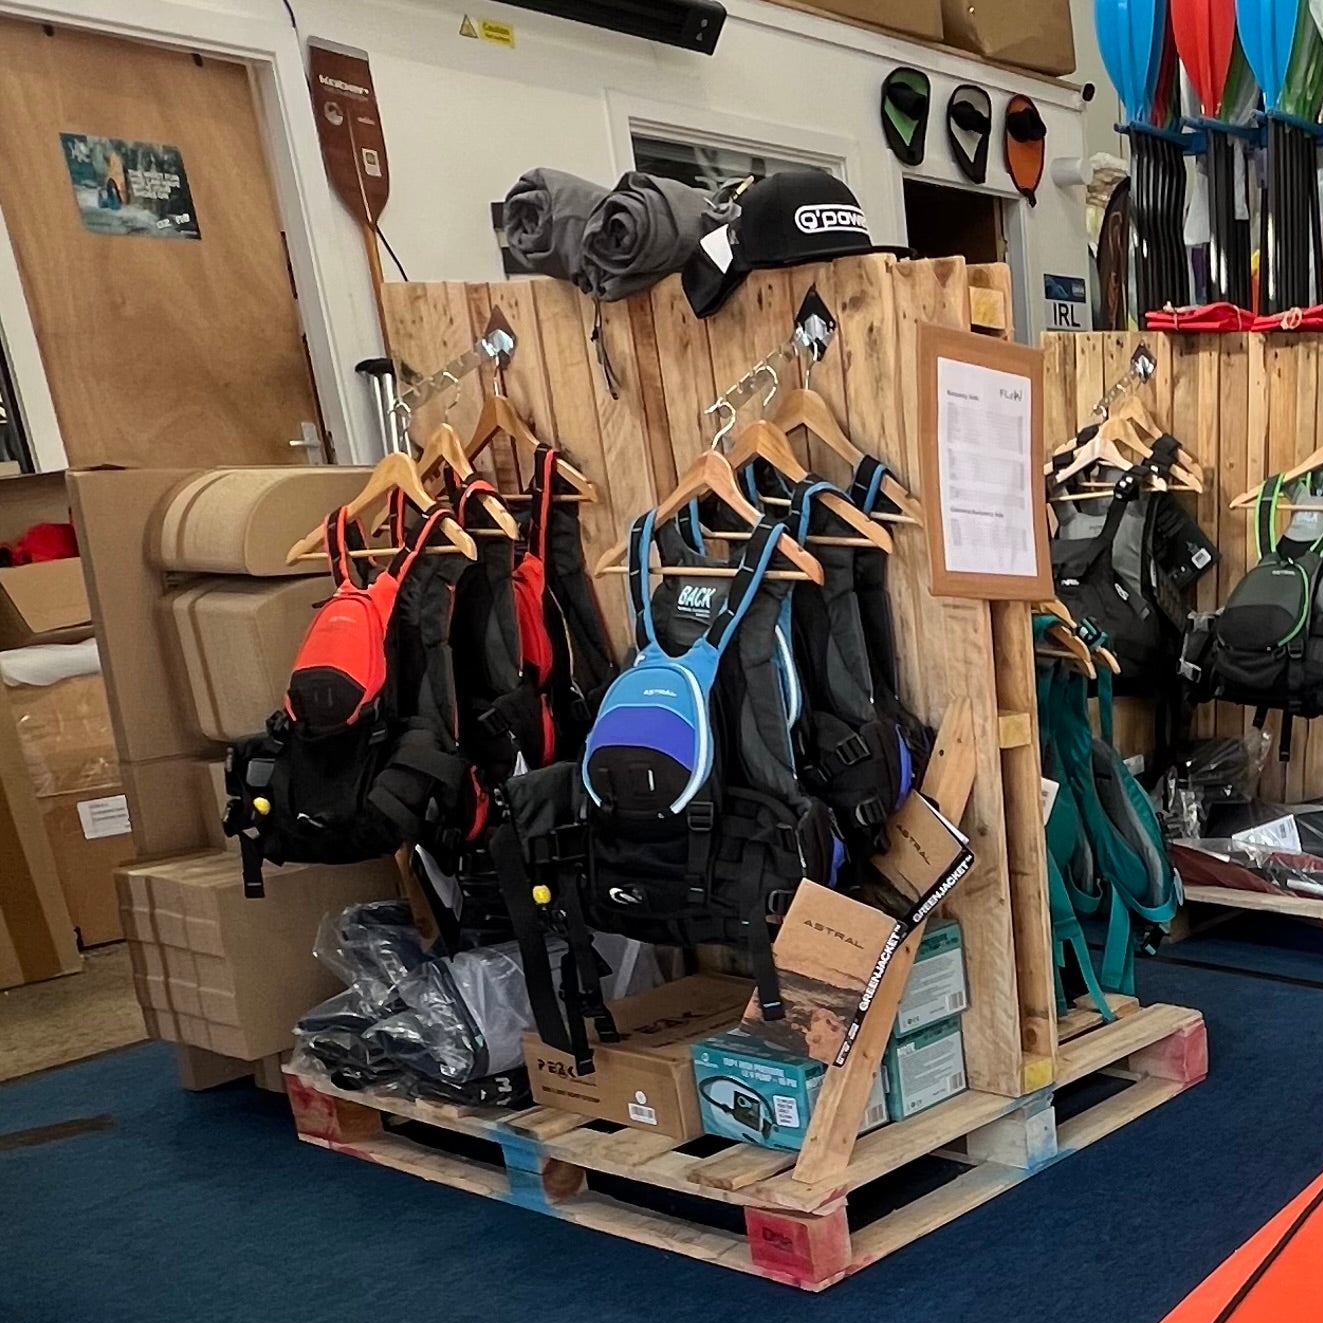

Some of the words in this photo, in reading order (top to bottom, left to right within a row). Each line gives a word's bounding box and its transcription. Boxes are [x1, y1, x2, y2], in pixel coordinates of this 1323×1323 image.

[1053, 302, 1081, 327] IRL
[677, 585, 716, 608] BACK
[896, 824, 930, 866] ASTRAL
[803, 919, 864, 950] ASTRAL
